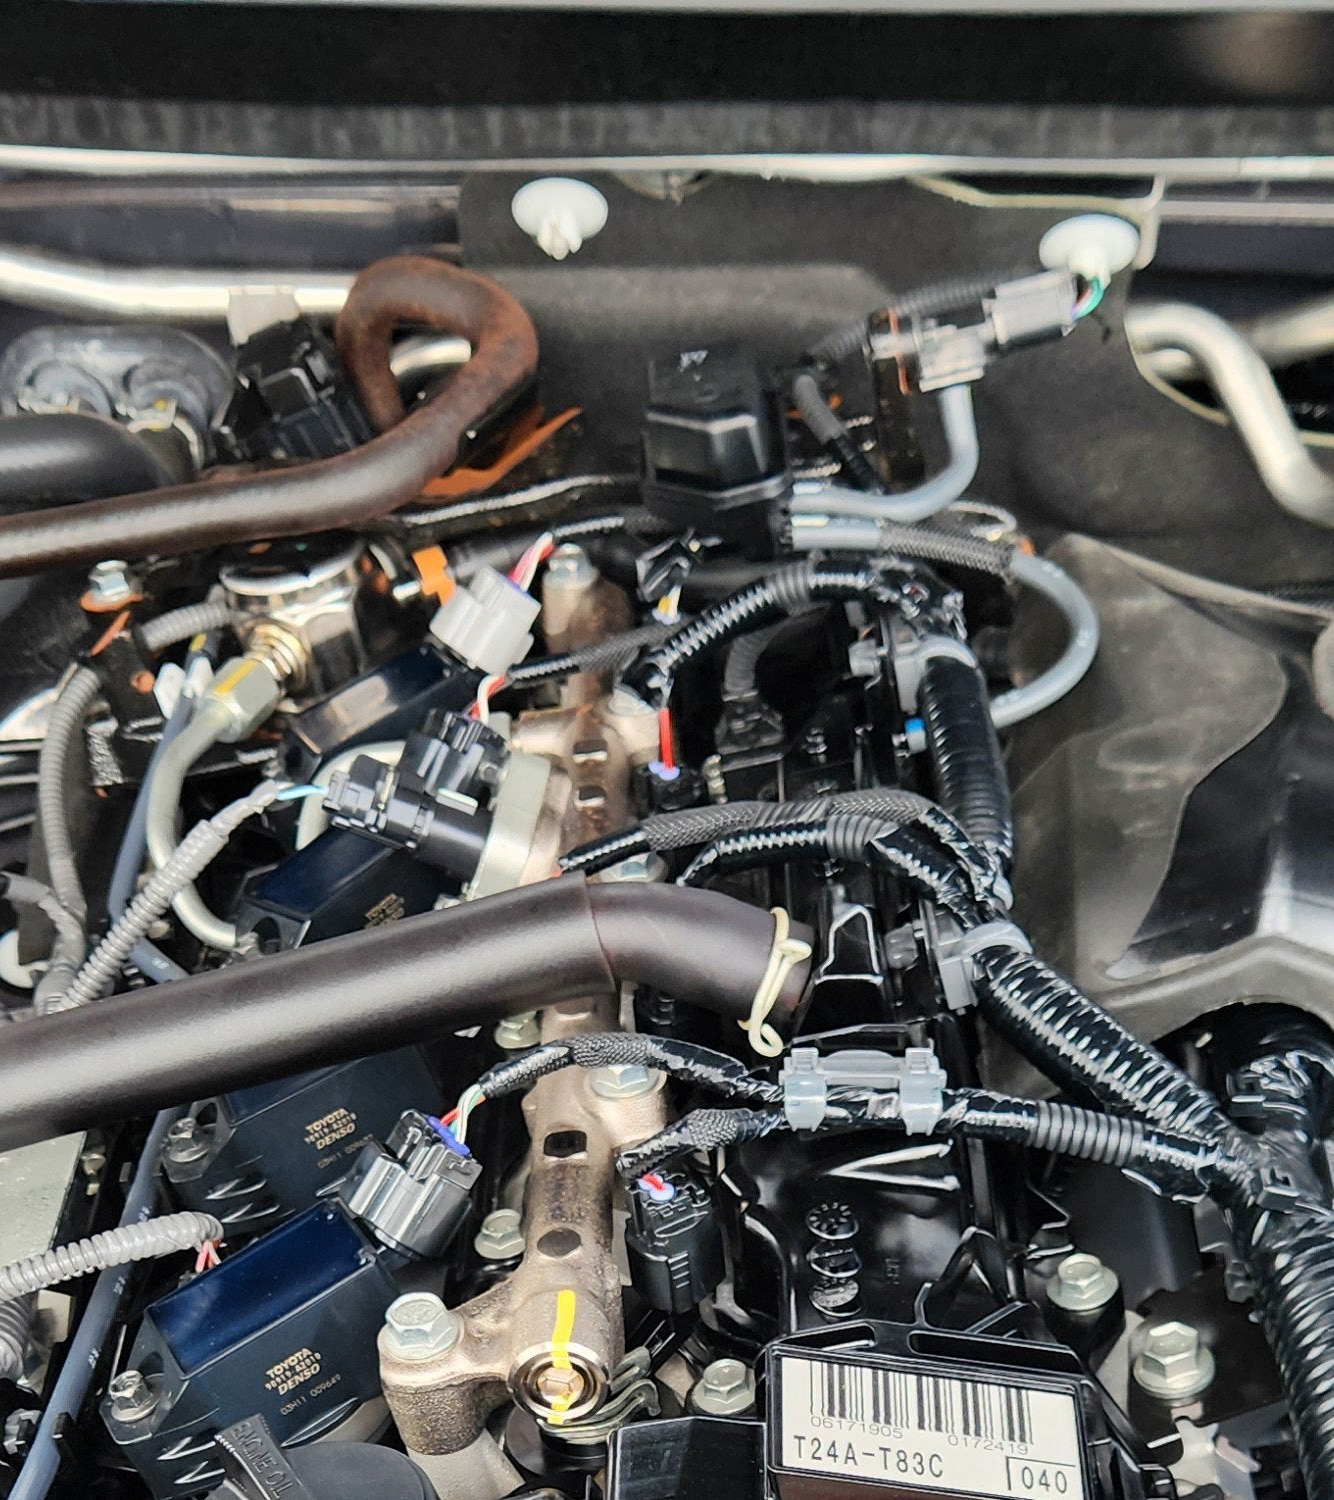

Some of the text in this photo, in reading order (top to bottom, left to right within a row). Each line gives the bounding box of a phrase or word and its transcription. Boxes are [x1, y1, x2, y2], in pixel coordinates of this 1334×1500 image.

[305, 1107, 350, 1134] TOYOTA
[316, 1122, 356, 1150] DENSO
[266, 1348, 313, 1379] TOYOTA
[277, 1363, 321, 1396] DENSO
[810, 1416, 1029, 1455] 06171905 0172419
[232, 1421, 294, 1499] ENGINE OIL
[793, 1435, 945, 1478] T24A-T83C
[1021, 1466, 1068, 1494] 040
